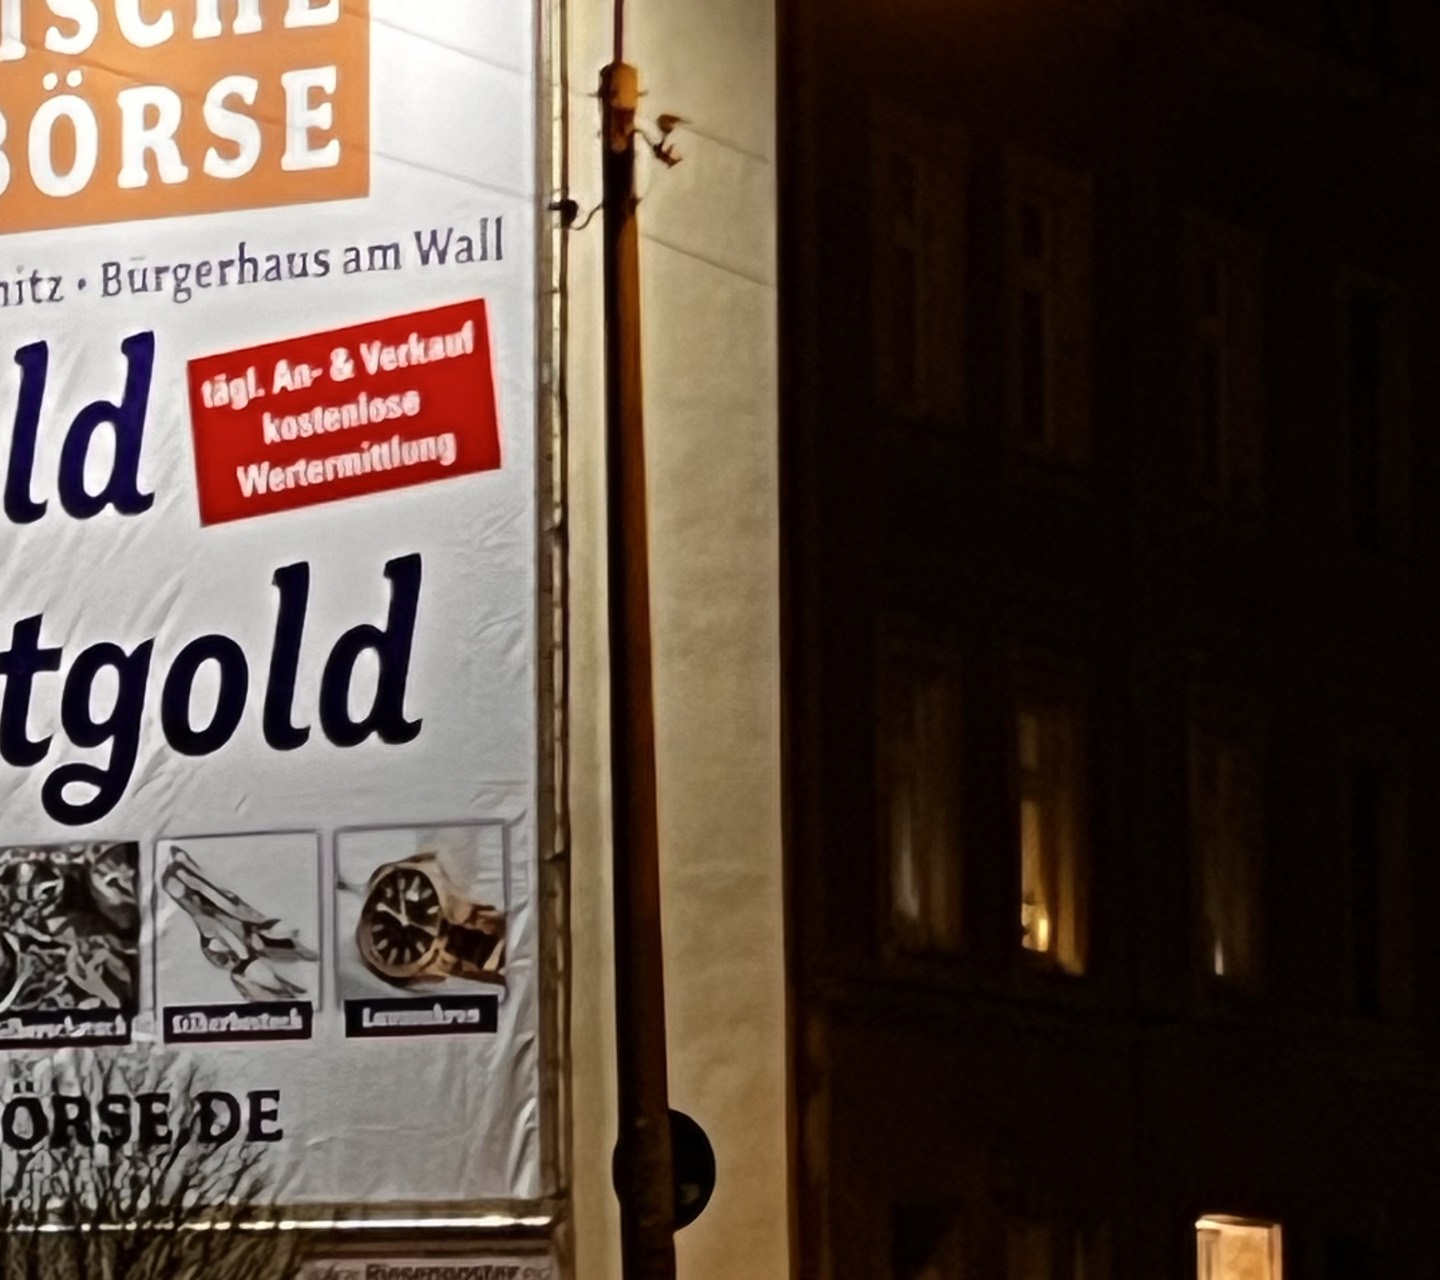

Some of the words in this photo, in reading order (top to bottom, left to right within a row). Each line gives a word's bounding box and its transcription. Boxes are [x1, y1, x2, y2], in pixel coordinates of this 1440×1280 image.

[100, 241, 330, 304] Bürgerhaus
[342, 241, 401, 275] am
[413, 216, 504, 268] Wall
[201, 365, 265, 410] tägl.
[272, 358, 323, 395] An-
[329, 347, 355, 382] &
[360, 319, 475, 376] Verkauf
[262, 389, 421, 445] kostenlose
[236, 432, 458, 498] Wertermittlung
